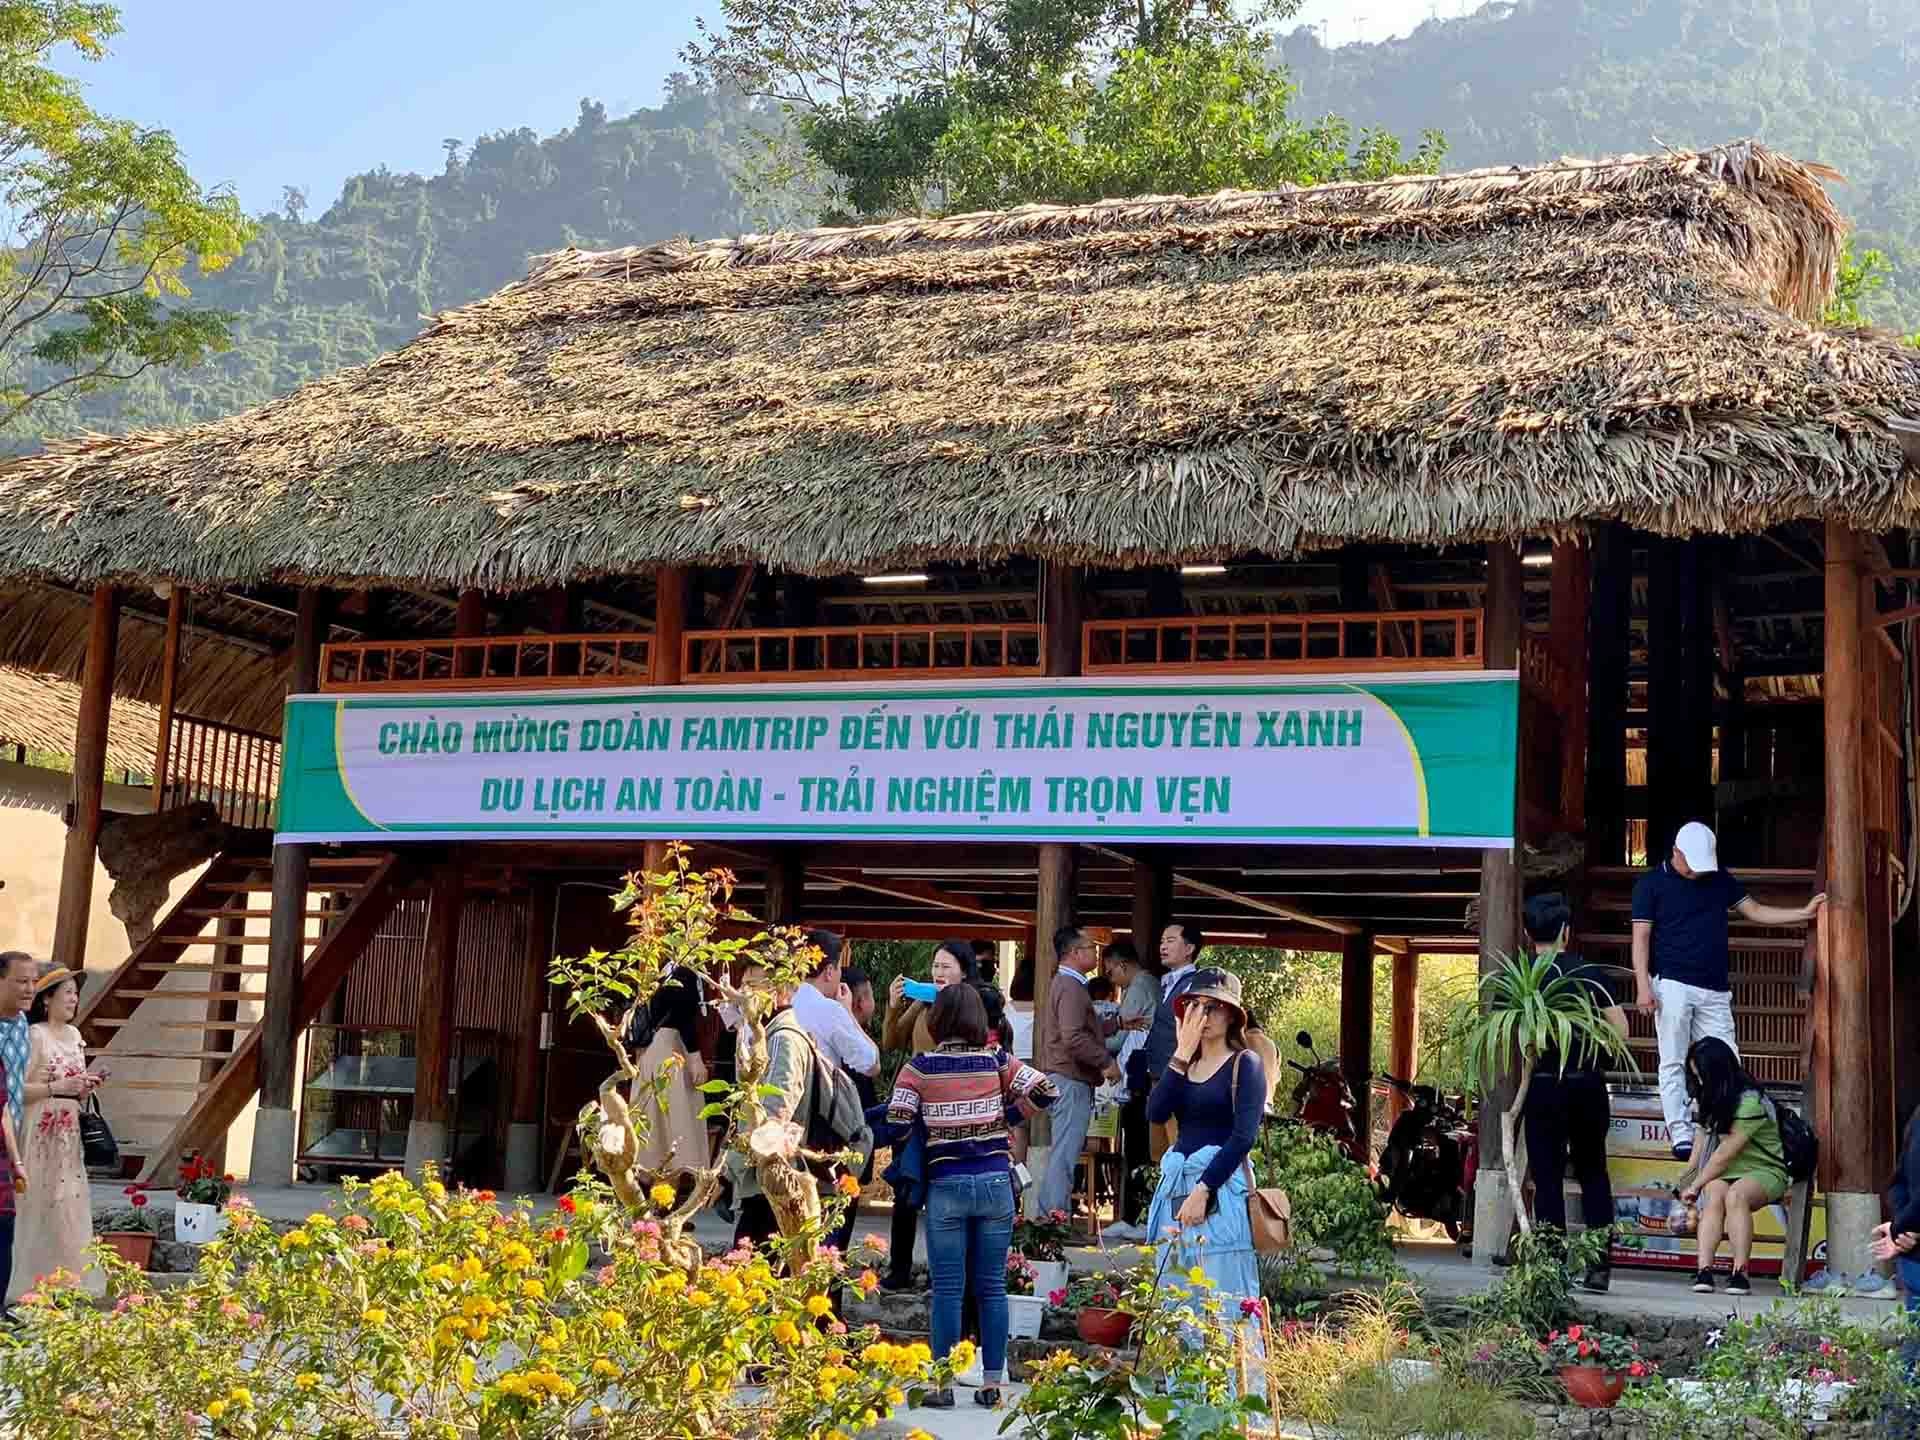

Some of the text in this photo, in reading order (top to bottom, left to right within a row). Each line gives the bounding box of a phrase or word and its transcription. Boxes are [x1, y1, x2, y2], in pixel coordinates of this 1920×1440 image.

[378, 703, 1363, 754] CHÀO MỪNG ĐOÀN FAMTRIP ĐẾN VỚI THÁI NGUYÊN XANH
[480, 765, 1232, 822] DU LỊCH AN TOÀN - TRẢI NGHIỆM TRỌN VẸN
[1640, 1124, 1672, 1142] BIA
